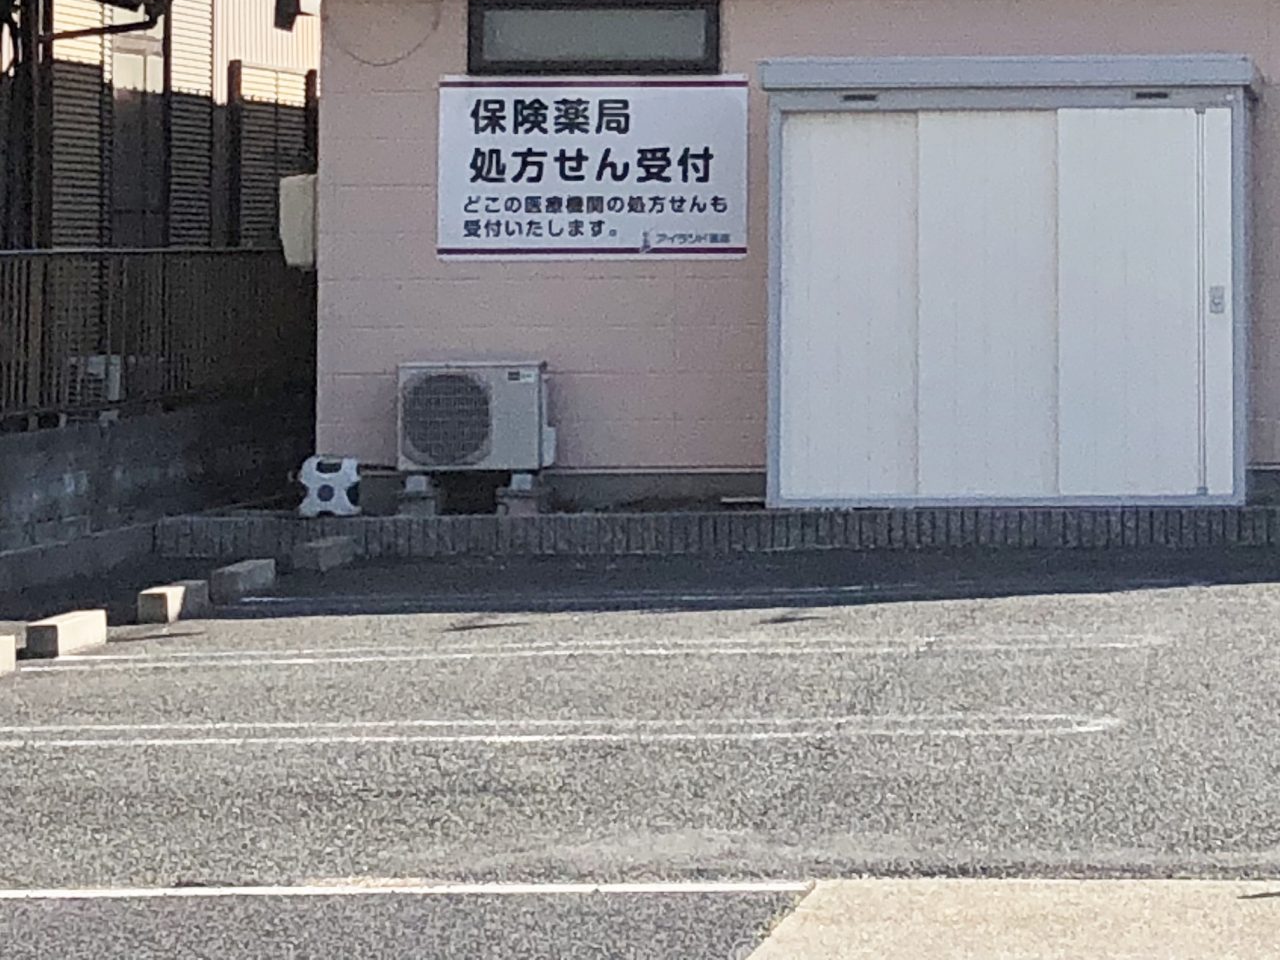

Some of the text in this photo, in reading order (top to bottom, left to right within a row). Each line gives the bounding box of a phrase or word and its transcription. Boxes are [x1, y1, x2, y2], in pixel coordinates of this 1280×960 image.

[469, 97, 632, 135] 保険薬局
[469, 145, 715, 184] 処方せん受付
[463, 194, 729, 215] どこの医療機関の処方せんも
[462, 218, 618, 239] 受付いたします。
